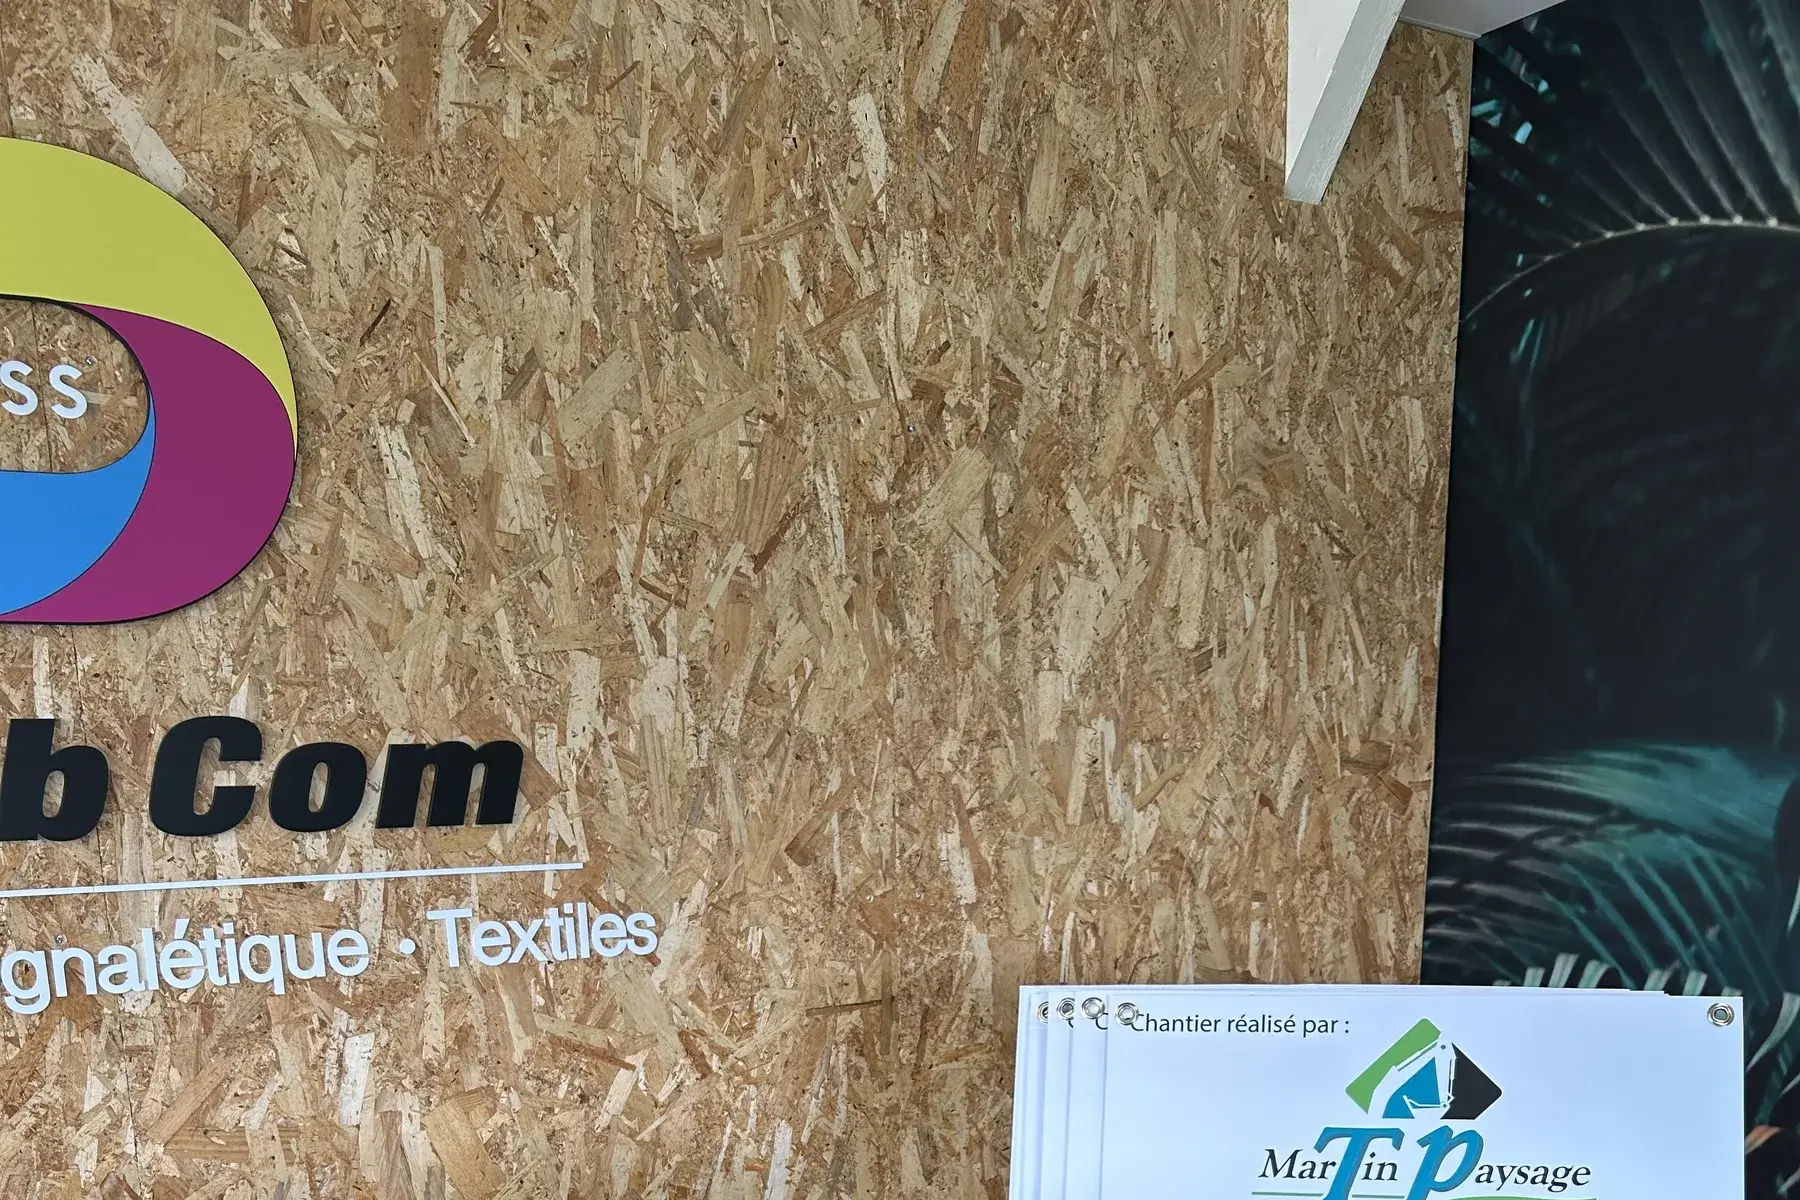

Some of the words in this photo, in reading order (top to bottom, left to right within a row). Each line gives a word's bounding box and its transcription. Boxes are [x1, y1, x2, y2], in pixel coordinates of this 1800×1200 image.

[148, 715, 524, 837] Com
[426, 902, 658, 967] Textiles
[1129, 1013, 1220, 1033] Chantier
[1227, 1014, 1296, 1034] réalisé
[1302, 1017, 1339, 1038] par
